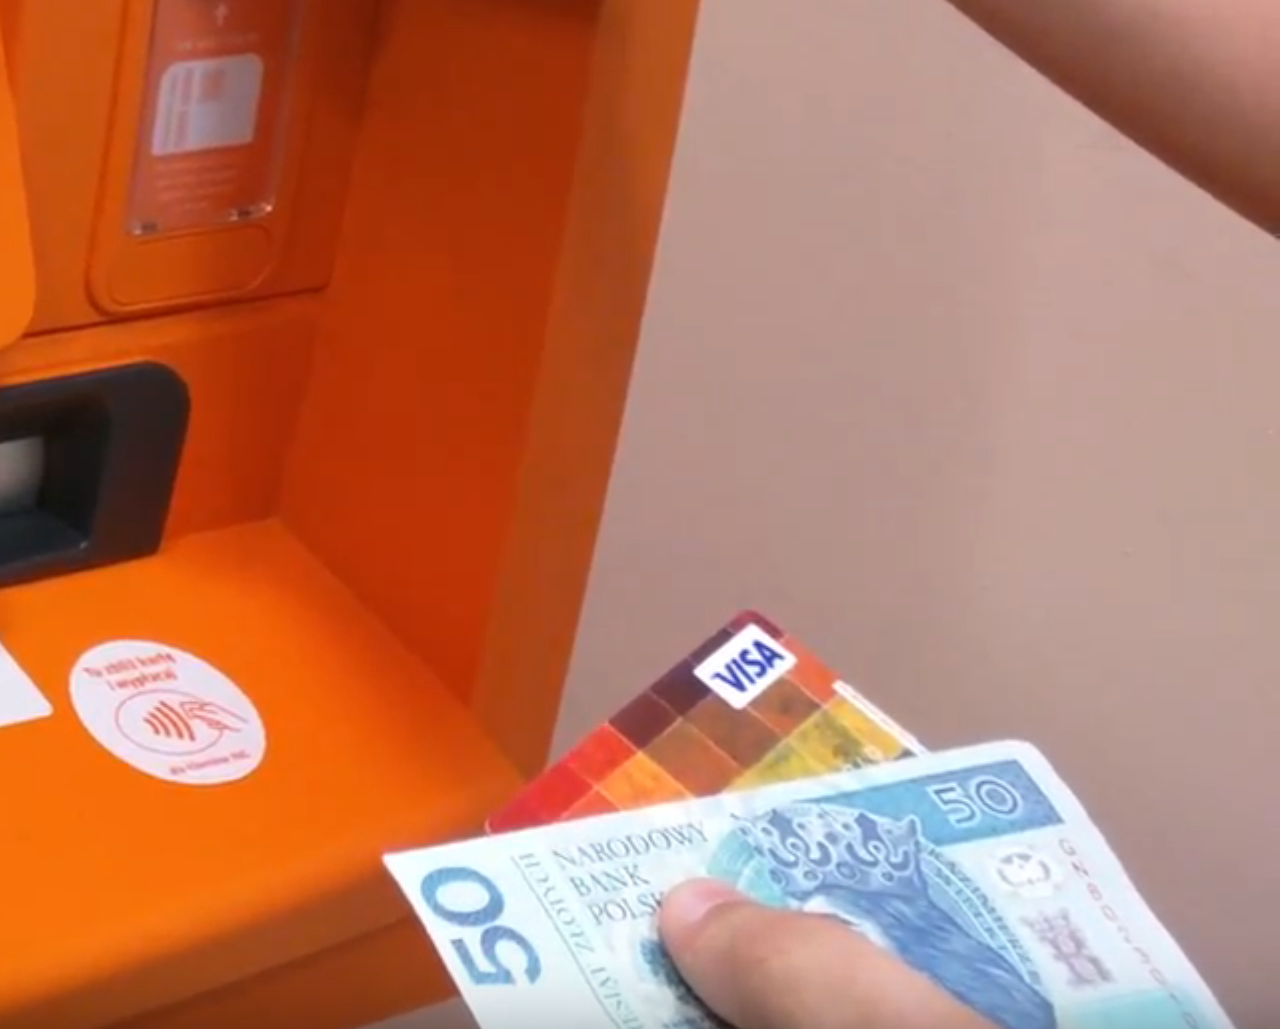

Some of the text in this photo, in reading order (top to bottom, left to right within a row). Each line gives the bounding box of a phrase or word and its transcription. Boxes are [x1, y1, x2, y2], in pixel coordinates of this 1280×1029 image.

[710, 639, 785, 693] VISA
[927, 774, 1022, 828] 50
[552, 822, 708, 869] NARODOWY
[569, 863, 651, 897] BANK
[421, 867, 542, 985] 50
